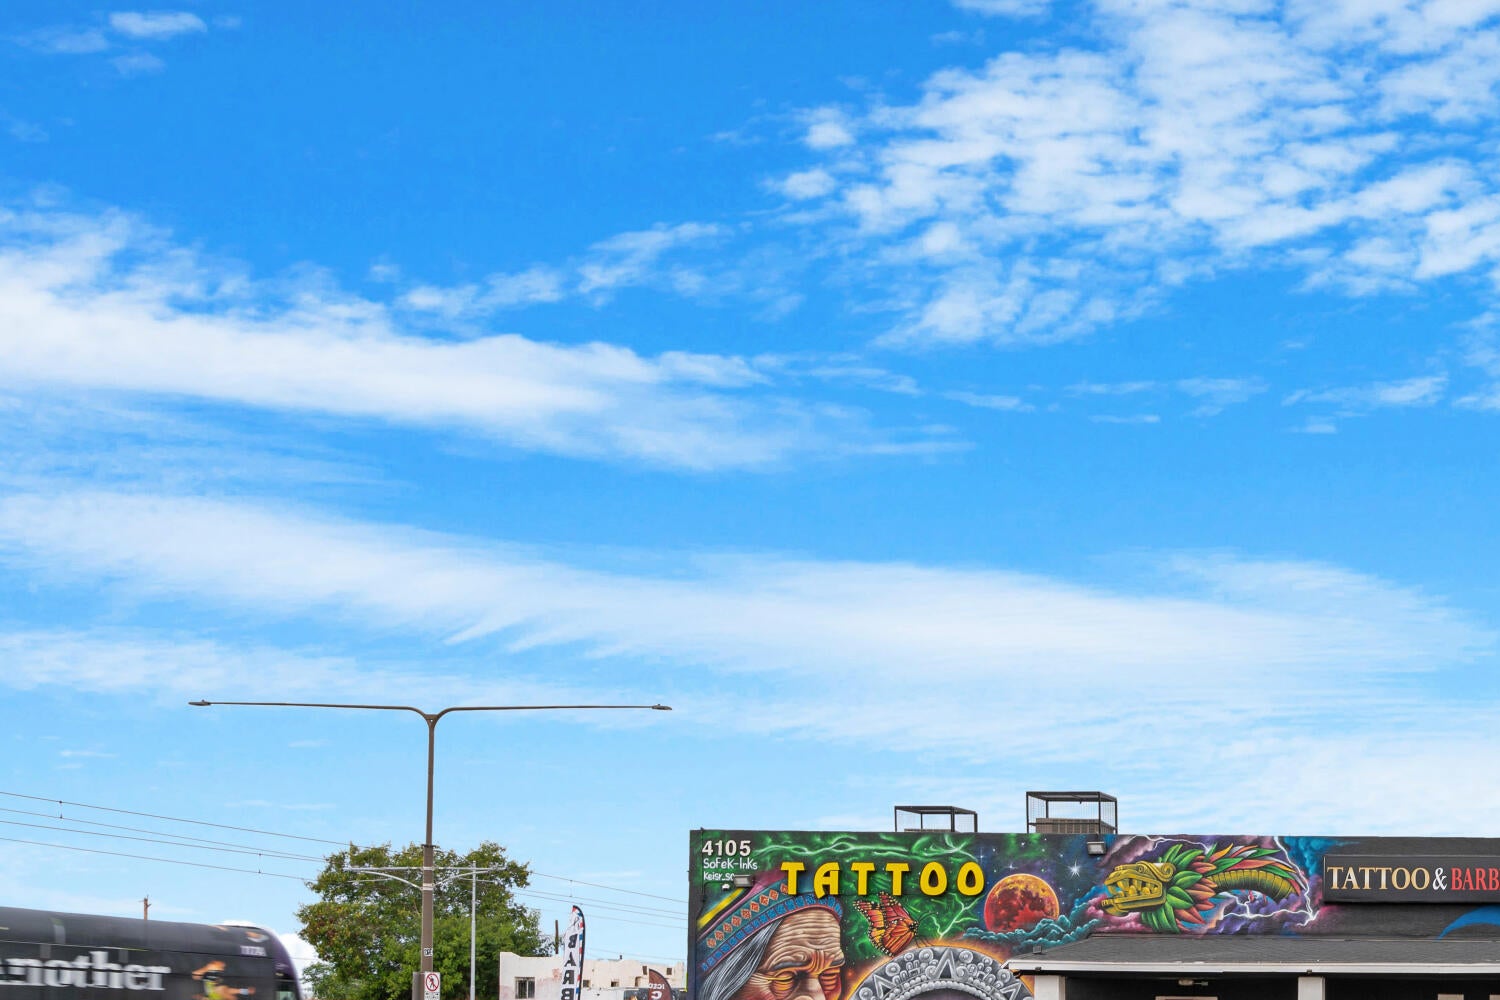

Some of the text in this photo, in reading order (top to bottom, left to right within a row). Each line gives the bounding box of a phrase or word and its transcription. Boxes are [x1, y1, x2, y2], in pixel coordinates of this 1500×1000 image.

[701, 839, 751, 857] 4105
[781, 861, 986, 899] TATTOO
[1327, 866, 1430, 891] TATTOO
[0, 950, 171, 990] nother
